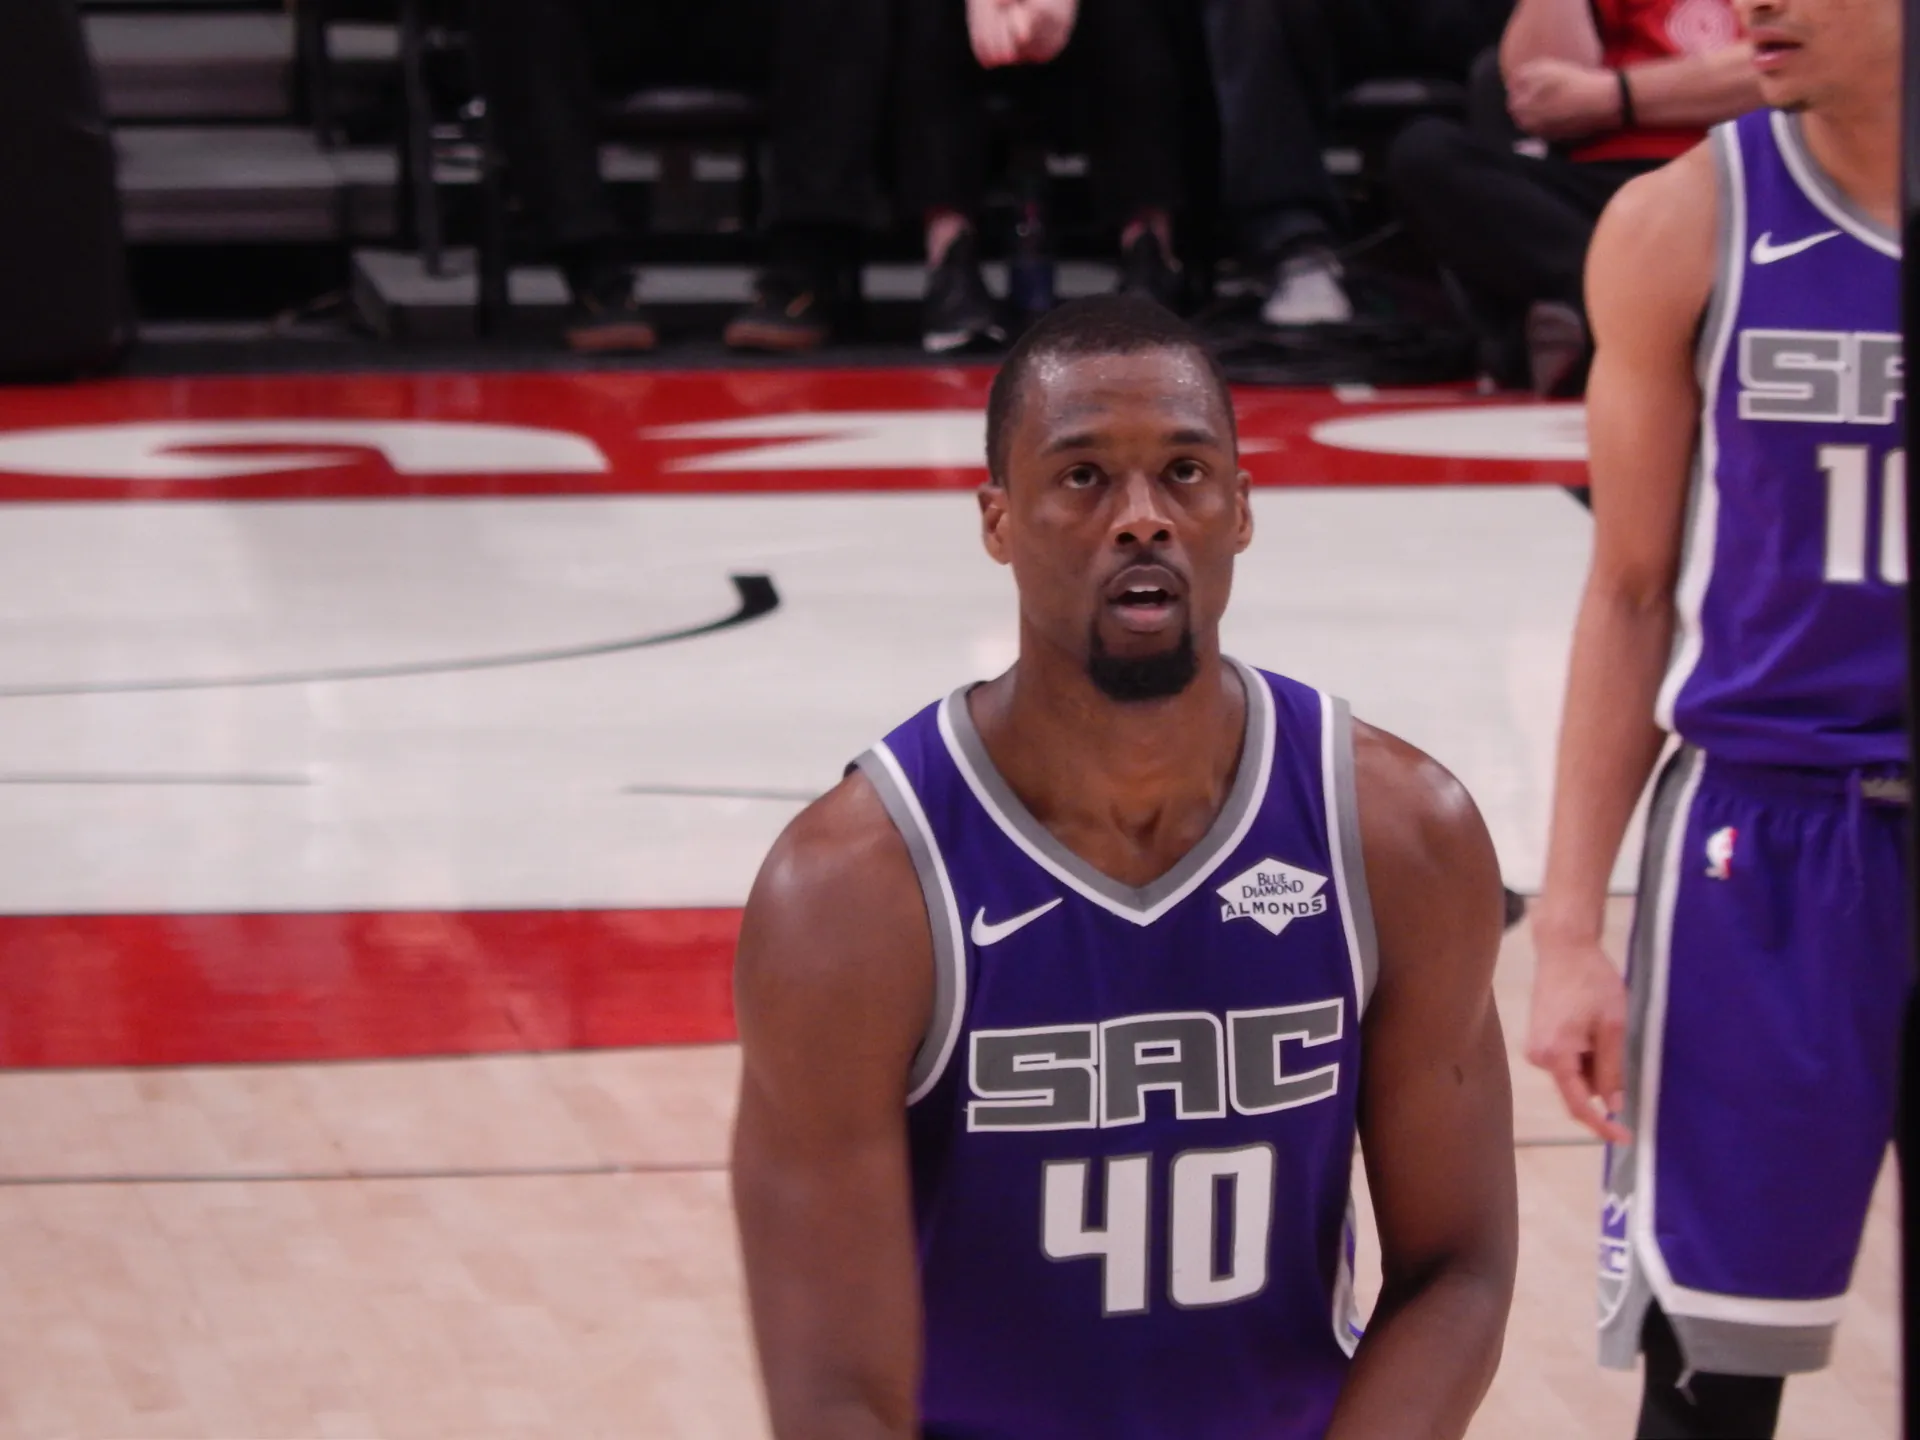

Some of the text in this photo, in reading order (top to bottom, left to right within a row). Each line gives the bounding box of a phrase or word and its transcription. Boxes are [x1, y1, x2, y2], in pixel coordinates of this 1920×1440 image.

[1257, 872, 1288, 887] BLUE
[1242, 880, 1304, 899] DIAMOND
[1226, 898, 1323, 917] ALMONDS
[967, 997, 1344, 1132] SAC
[1040, 1141, 1277, 1318] 40
